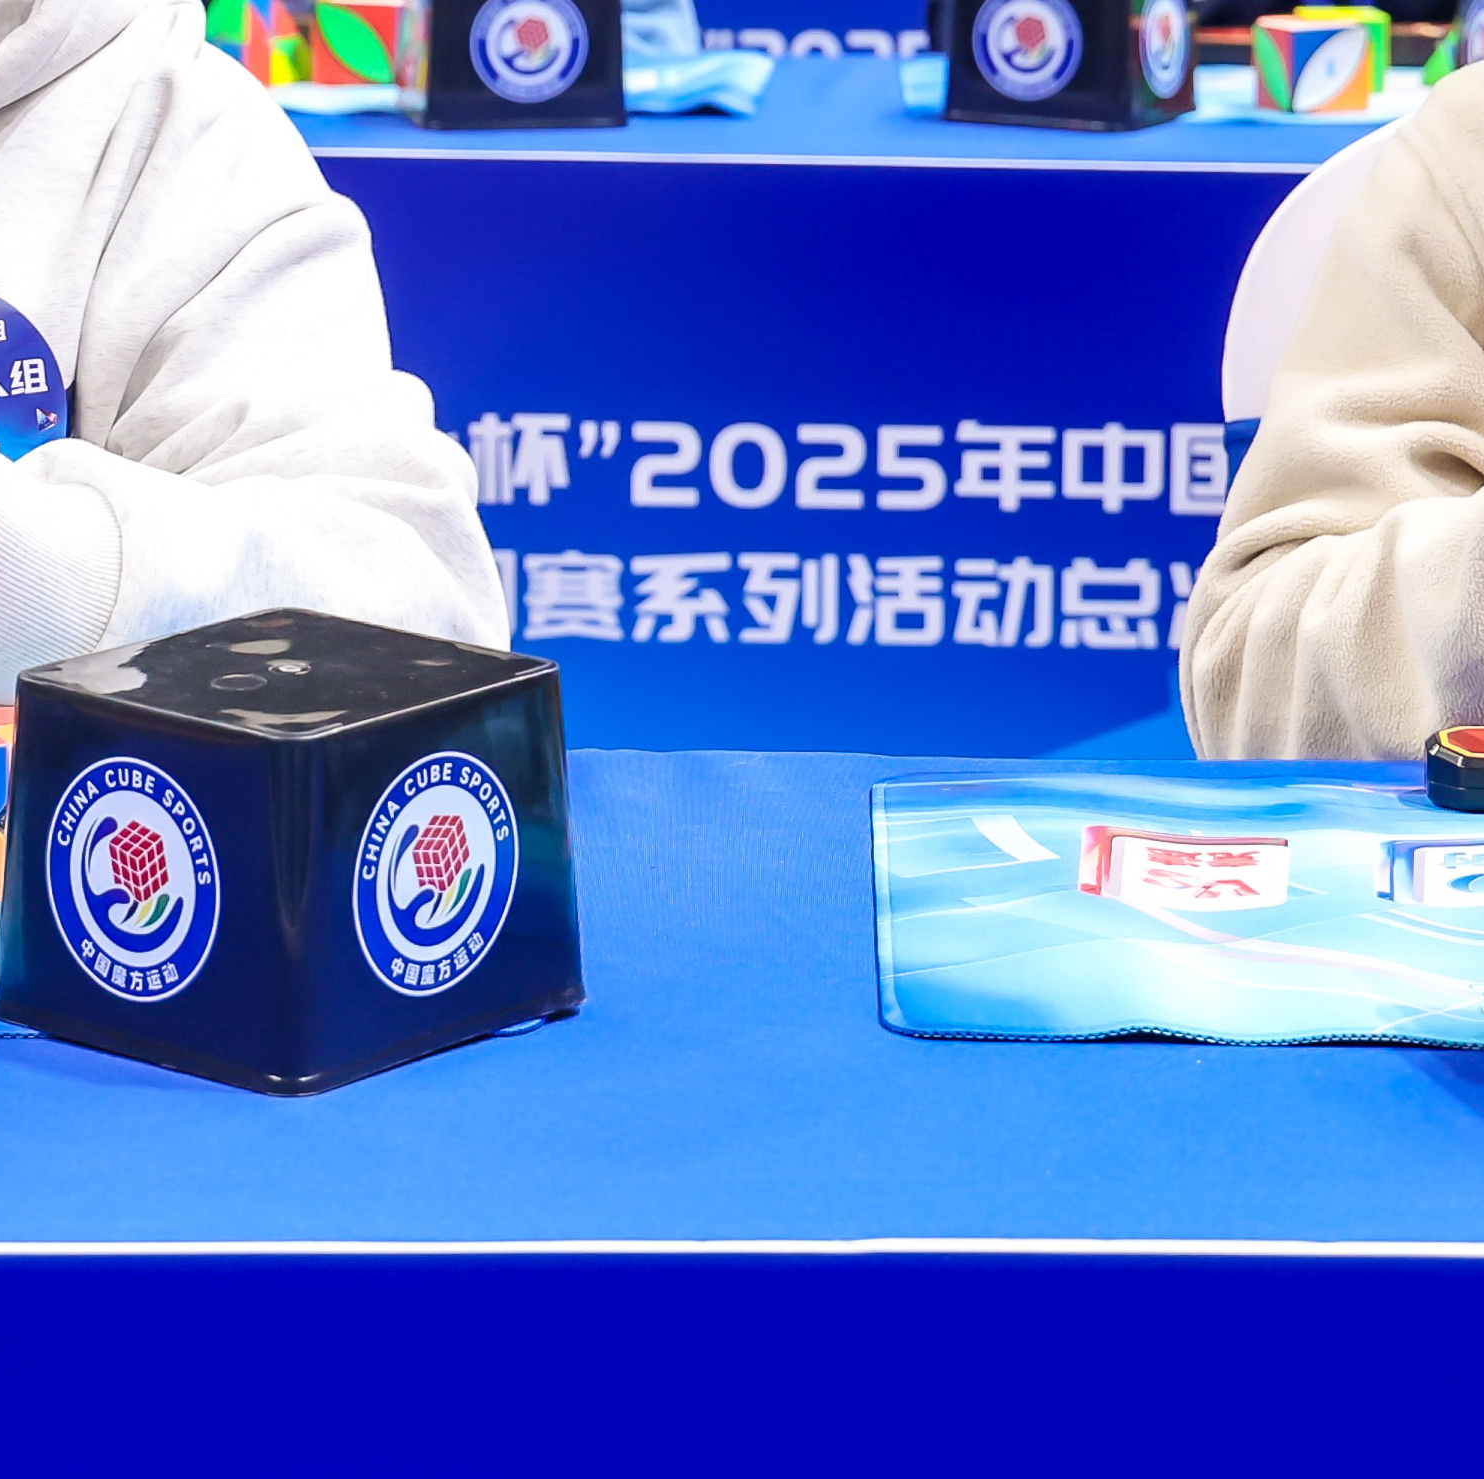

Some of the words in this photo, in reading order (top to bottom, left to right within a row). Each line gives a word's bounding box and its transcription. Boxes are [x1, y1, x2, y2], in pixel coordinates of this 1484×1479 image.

[489, 548, 1194, 652] 赛系列活动总
[57, 780, 99, 846] CHINA
[105, 768, 155, 794] CUBE
[162, 789, 211, 885] SPORTS
[362, 800, 400, 880] CHINA
[404, 762, 452, 796] CUBE
[459, 766, 509, 841] SPORTS
[81, 938, 179, 991] 中国魔方运动
[391, 931, 485, 986] 中国魔方运动
